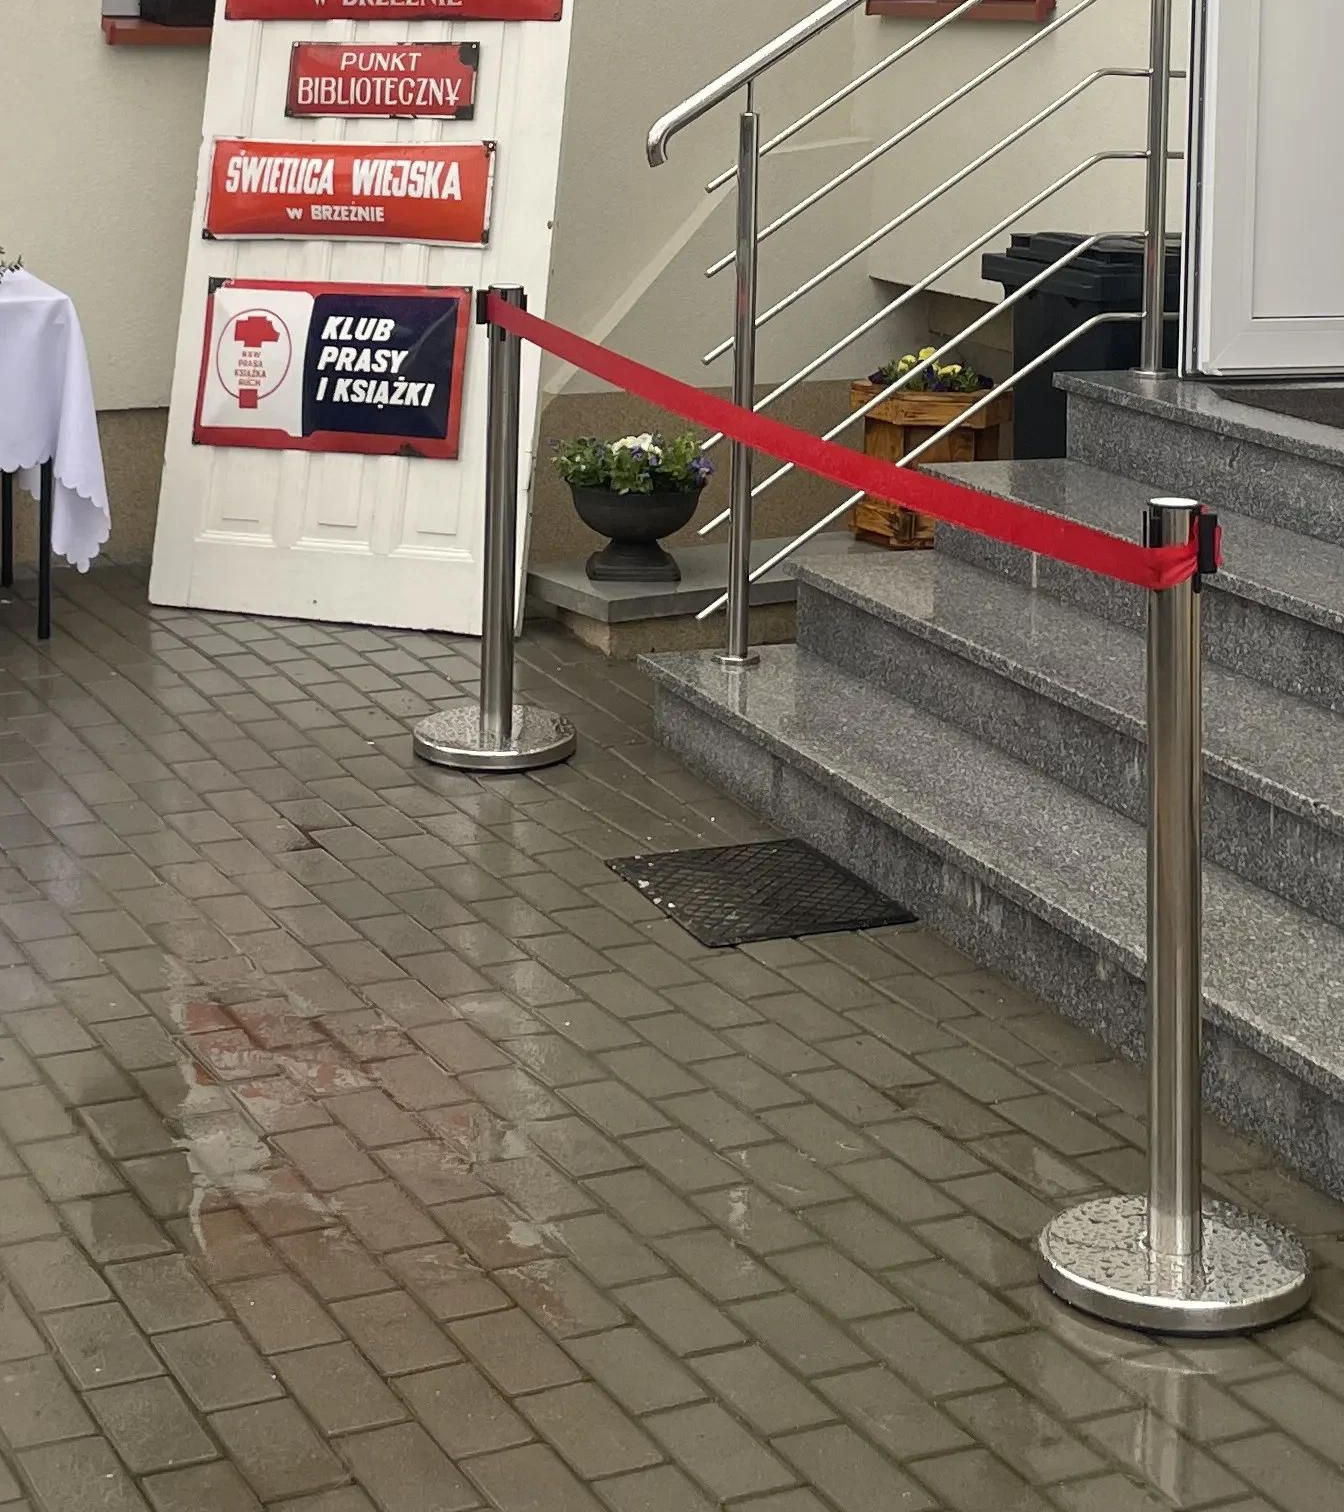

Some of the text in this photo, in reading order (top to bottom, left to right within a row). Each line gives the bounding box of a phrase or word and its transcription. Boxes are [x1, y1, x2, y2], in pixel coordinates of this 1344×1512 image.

[340, 51, 423, 73] PUNKT
[296, 76, 463, 107] BIBLIOTECZNY
[224, 149, 463, 202] ŚWIETLICA WIEJSKA
[320, 315, 396, 342] KLUB
[316, 345, 410, 374] PRASY
[315, 375, 436, 410] I KSIĄŻKI
